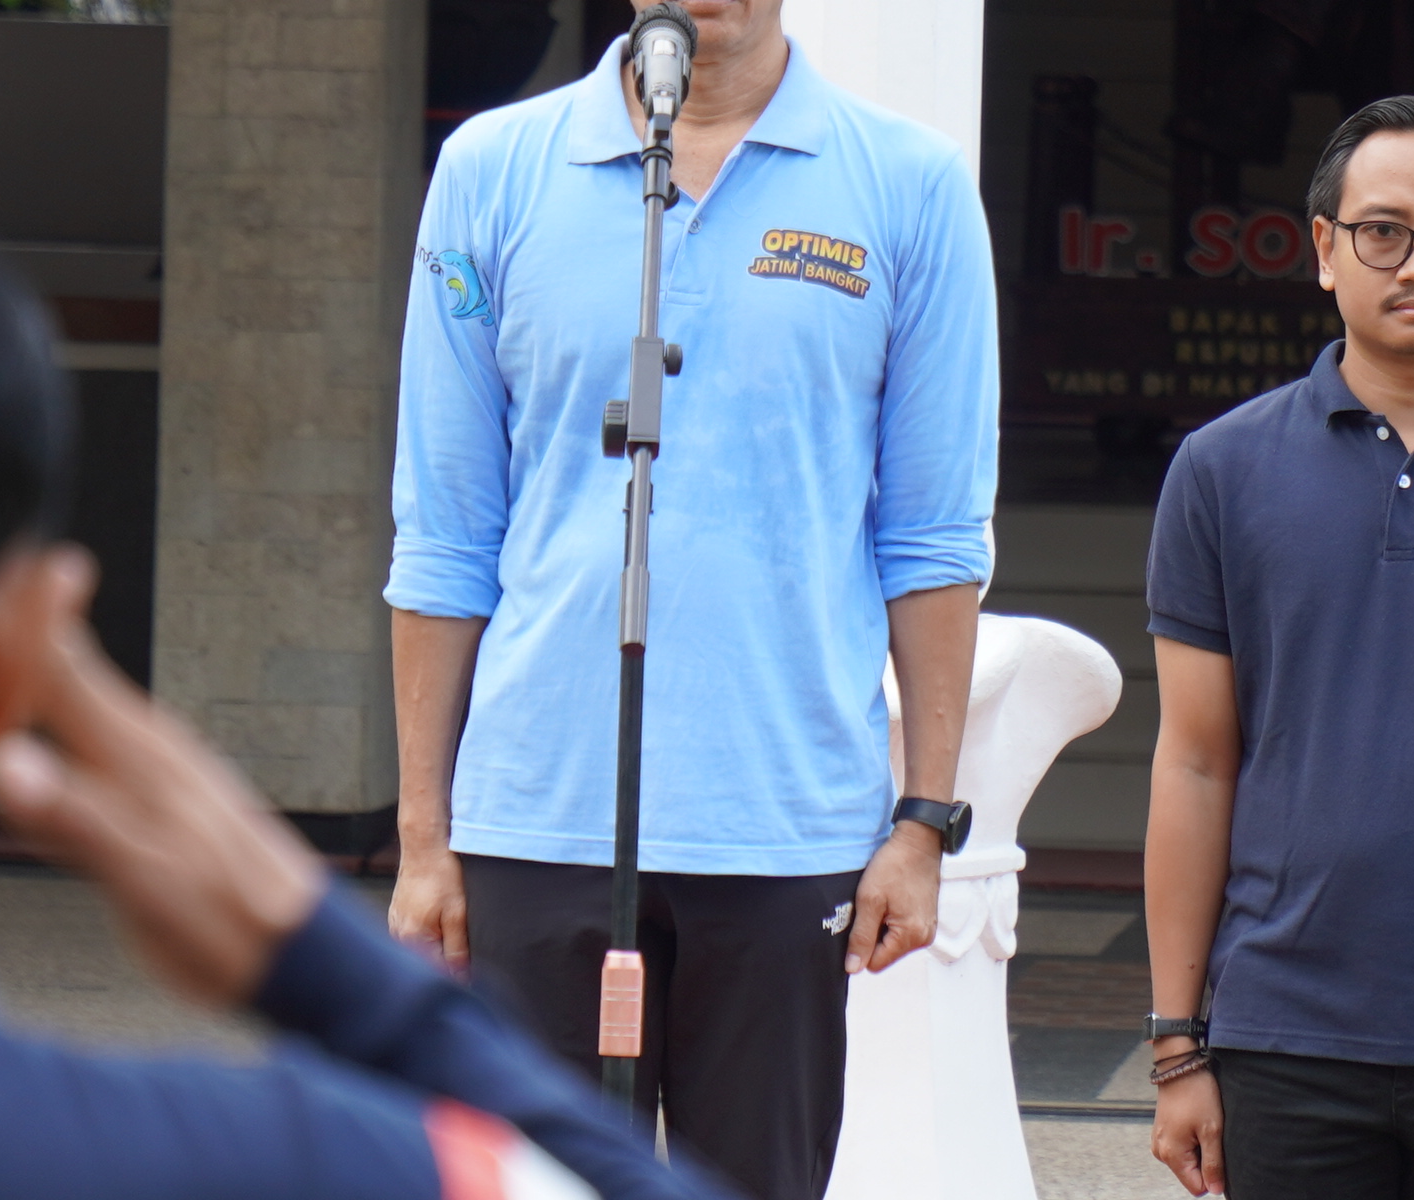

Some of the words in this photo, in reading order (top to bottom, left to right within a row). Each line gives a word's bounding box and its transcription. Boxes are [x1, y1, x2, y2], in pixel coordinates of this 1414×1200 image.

[763, 231, 867, 271] OPTIMIS
[1059, 205, 1161, 278] Ir.
[750, 259, 798, 275] JATIM
[803, 261, 869, 296] BANGKIT
